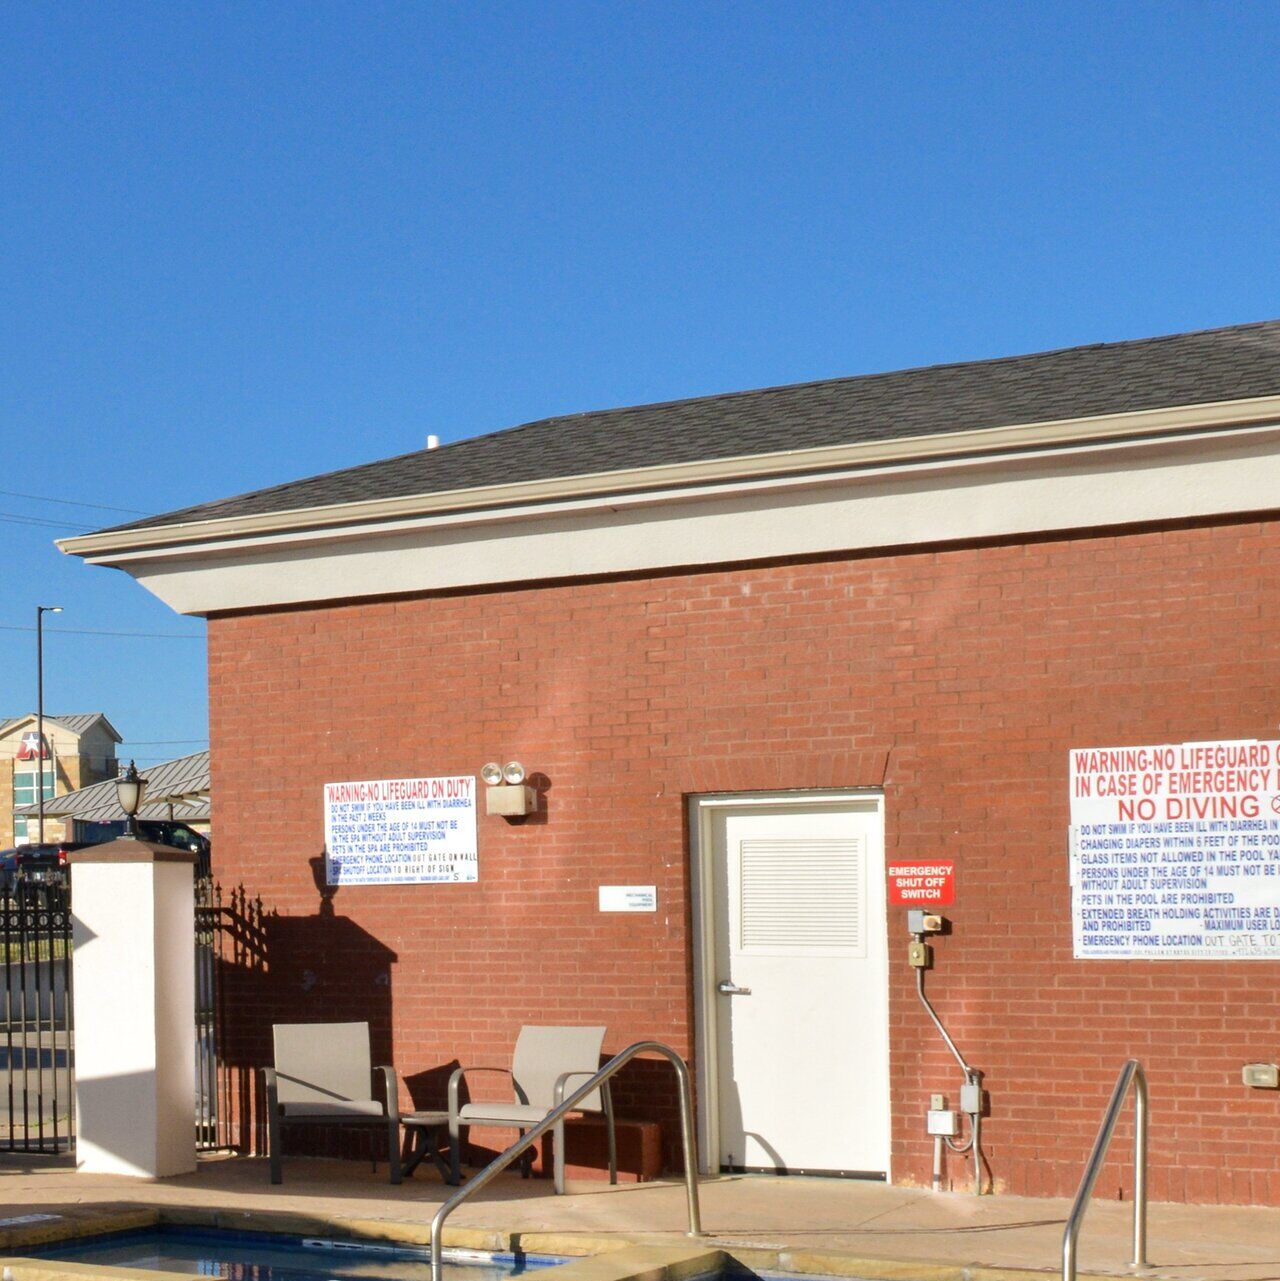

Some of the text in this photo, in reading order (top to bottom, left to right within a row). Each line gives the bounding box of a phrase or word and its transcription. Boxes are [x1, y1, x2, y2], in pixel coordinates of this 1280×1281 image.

[1181, 745, 1270, 770] LIFEGUARD
[382, 780, 429, 801] LIFEGUARD
[431, 780, 444, 798] ON
[447, 778, 471, 798] DUTY
[1075, 775, 1091, 797] IN
[1096, 774, 1137, 797] CASE
[1142, 773, 1163, 795] OF
[1168, 769, 1271, 794] EMERGENCY
[339, 803, 349, 813] NOT
[351, 803, 365, 812] SWIM
[373, 802, 383, 811] YOU
[385, 801, 399, 811] HAVE
[401, 801, 416, 810] BEEN
[427, 800, 441, 809] WITH
[443, 799, 471, 808] DIARRHEA
[1118, 795, 1260, 821] NO DIVING
[338, 814, 348, 822] THE
[368, 812, 386, 821] WEEKS
[331, 824, 356, 833] PERSONS
[357, 824, 375, 833] UNDER
[377, 823, 387, 832] THE
[389, 822, 400, 831] AGE
[401, 822, 409, 831] OF
[419, 821, 435, 830] MUST
[436, 820, 448, 830] NOT
[450, 820, 458, 829] BE
[1081, 819, 1278, 835] DO NOT SWIM IF YOU HAVE BEEN ILL WITH DIARRHEA IN
[339, 834, 349, 843] THE
[351, 834, 361, 843] SPA
[362, 833, 386, 842] WITHOUT
[388, 832, 406, 842] ADULT
[407, 831, 446, 841] SUPERVISION
[1080, 838, 1123, 850] CHANGING
[1126, 837, 1161, 849] DIAPERS
[1163, 837, 1193, 848] WITHIN
[1204, 836, 1225, 847] FEET
[1228, 835, 1239, 846] OF
[1242, 835, 1259, 846] THE
[1261, 834, 1280, 845] POO
[332, 845, 346, 854] PETS
[355, 844, 365, 853] THE
[367, 844, 378, 853] SPA
[380, 843, 391, 852] ARE
[392, 842, 428, 852] PROHIBITED
[332, 852, 477, 865] EMERGENCY PHONE LOCATION OUT GATE ON WALL
[1081, 853, 1109, 864] GLASS
[1111, 853, 1138, 864] ITEMS
[1140, 852, 1158, 863] NOT
[1161, 852, 1203, 862] ALLOWED
[1206, 851, 1216, 862] IN
[1219, 850, 1237, 861] THE
[1240, 850, 1264, 861] POOL
[367, 865, 391, 874] LOCATION
[393, 865, 401, 874] TO
[404, 865, 424, 873] RIGHT
[427, 864, 436, 873] OF
[438, 864, 455, 873] SIGN
[888, 866, 953, 876] EMERGENCY
[1081, 864, 1275, 878] PERSONS UNDER THE AGE OF 14 MUST NOT BE
[896, 877, 946, 888] SHUT OFF
[1082, 878, 1207, 890] WITHOUT ADULT SUPERVISION
[901, 889, 941, 899] SWITCH
[1081, 892, 1235, 905] PETS IN THE POOL ARE PROHIBITED
[1081, 908, 1125, 919] EXTENDED
[1127, 908, 1160, 919] BREATH
[1162, 908, 1200, 919] HOLDING
[1203, 907, 1251, 918] ACTIVITIES
[1253, 907, 1271, 918] ARE
[1082, 920, 1151, 931] AND PROHIBITED
[1204, 920, 1244, 931] MAXIMUM
[1246, 919, 1268, 930] USER
[1083, 935, 1130, 946] EMERGENCY
[1132, 935, 1160, 946] PHONE
[1162, 934, 1202, 946] LOCATION
[1205, 935, 1224, 947] OUT
[1229, 934, 1257, 947] GATE
